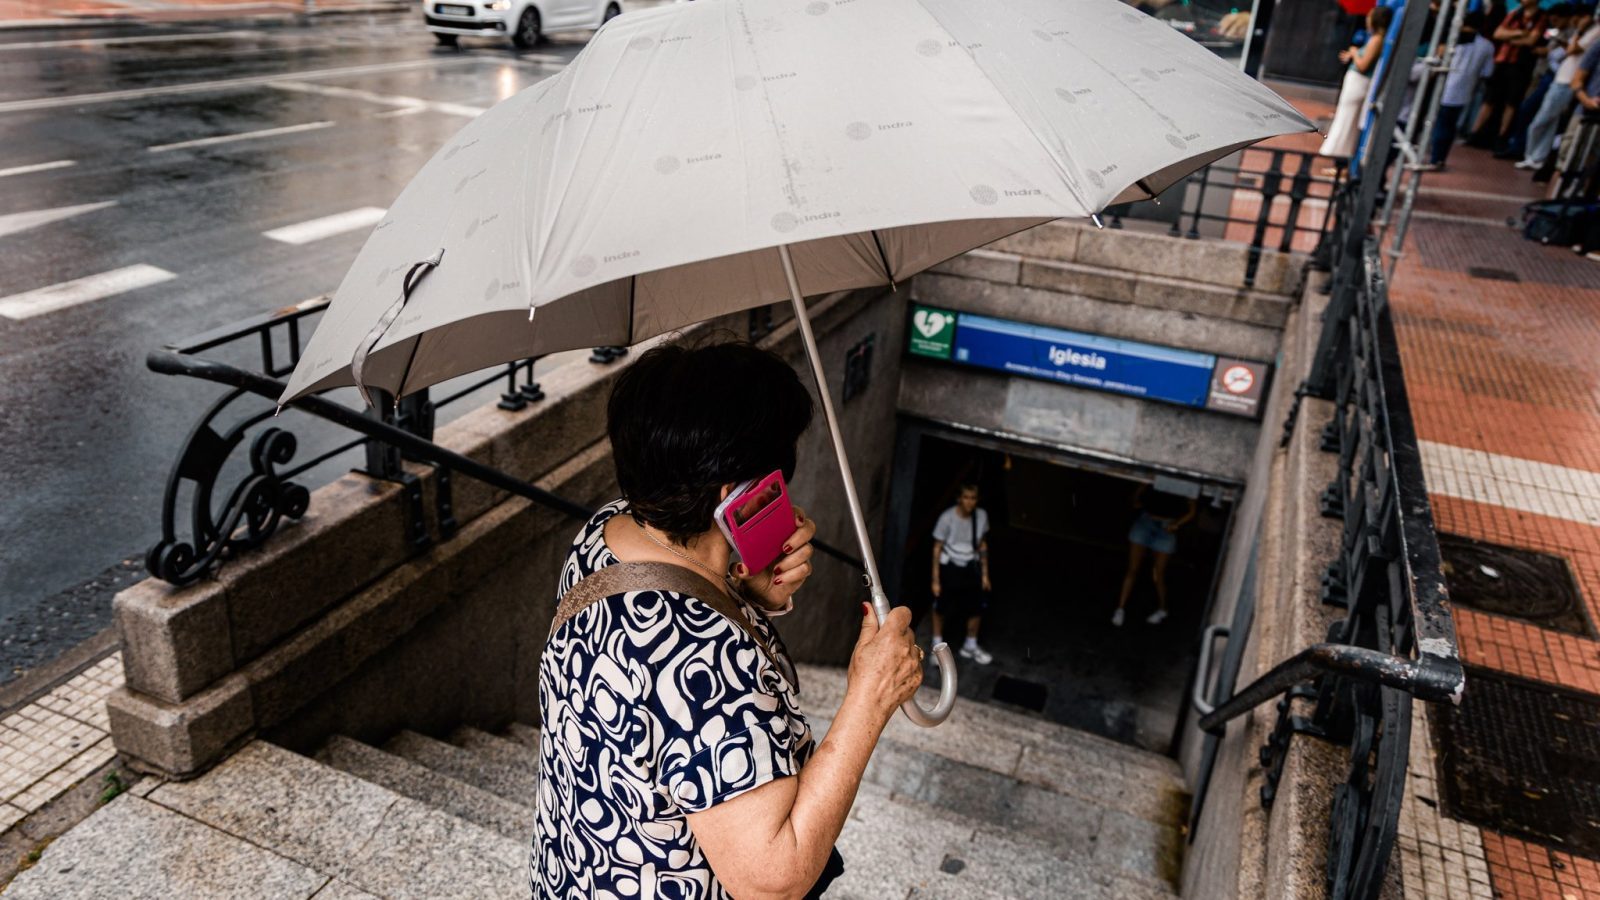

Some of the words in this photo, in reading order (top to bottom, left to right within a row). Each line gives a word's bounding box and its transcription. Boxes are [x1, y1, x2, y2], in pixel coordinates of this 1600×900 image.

[877, 120, 913, 131] Indra
[687, 151, 723, 164] Indra
[1003, 188, 1042, 197] Indra
[804, 210, 841, 222] Indra
[603, 249, 641, 263] Indra
[1048, 345, 1107, 370] Iglesia
